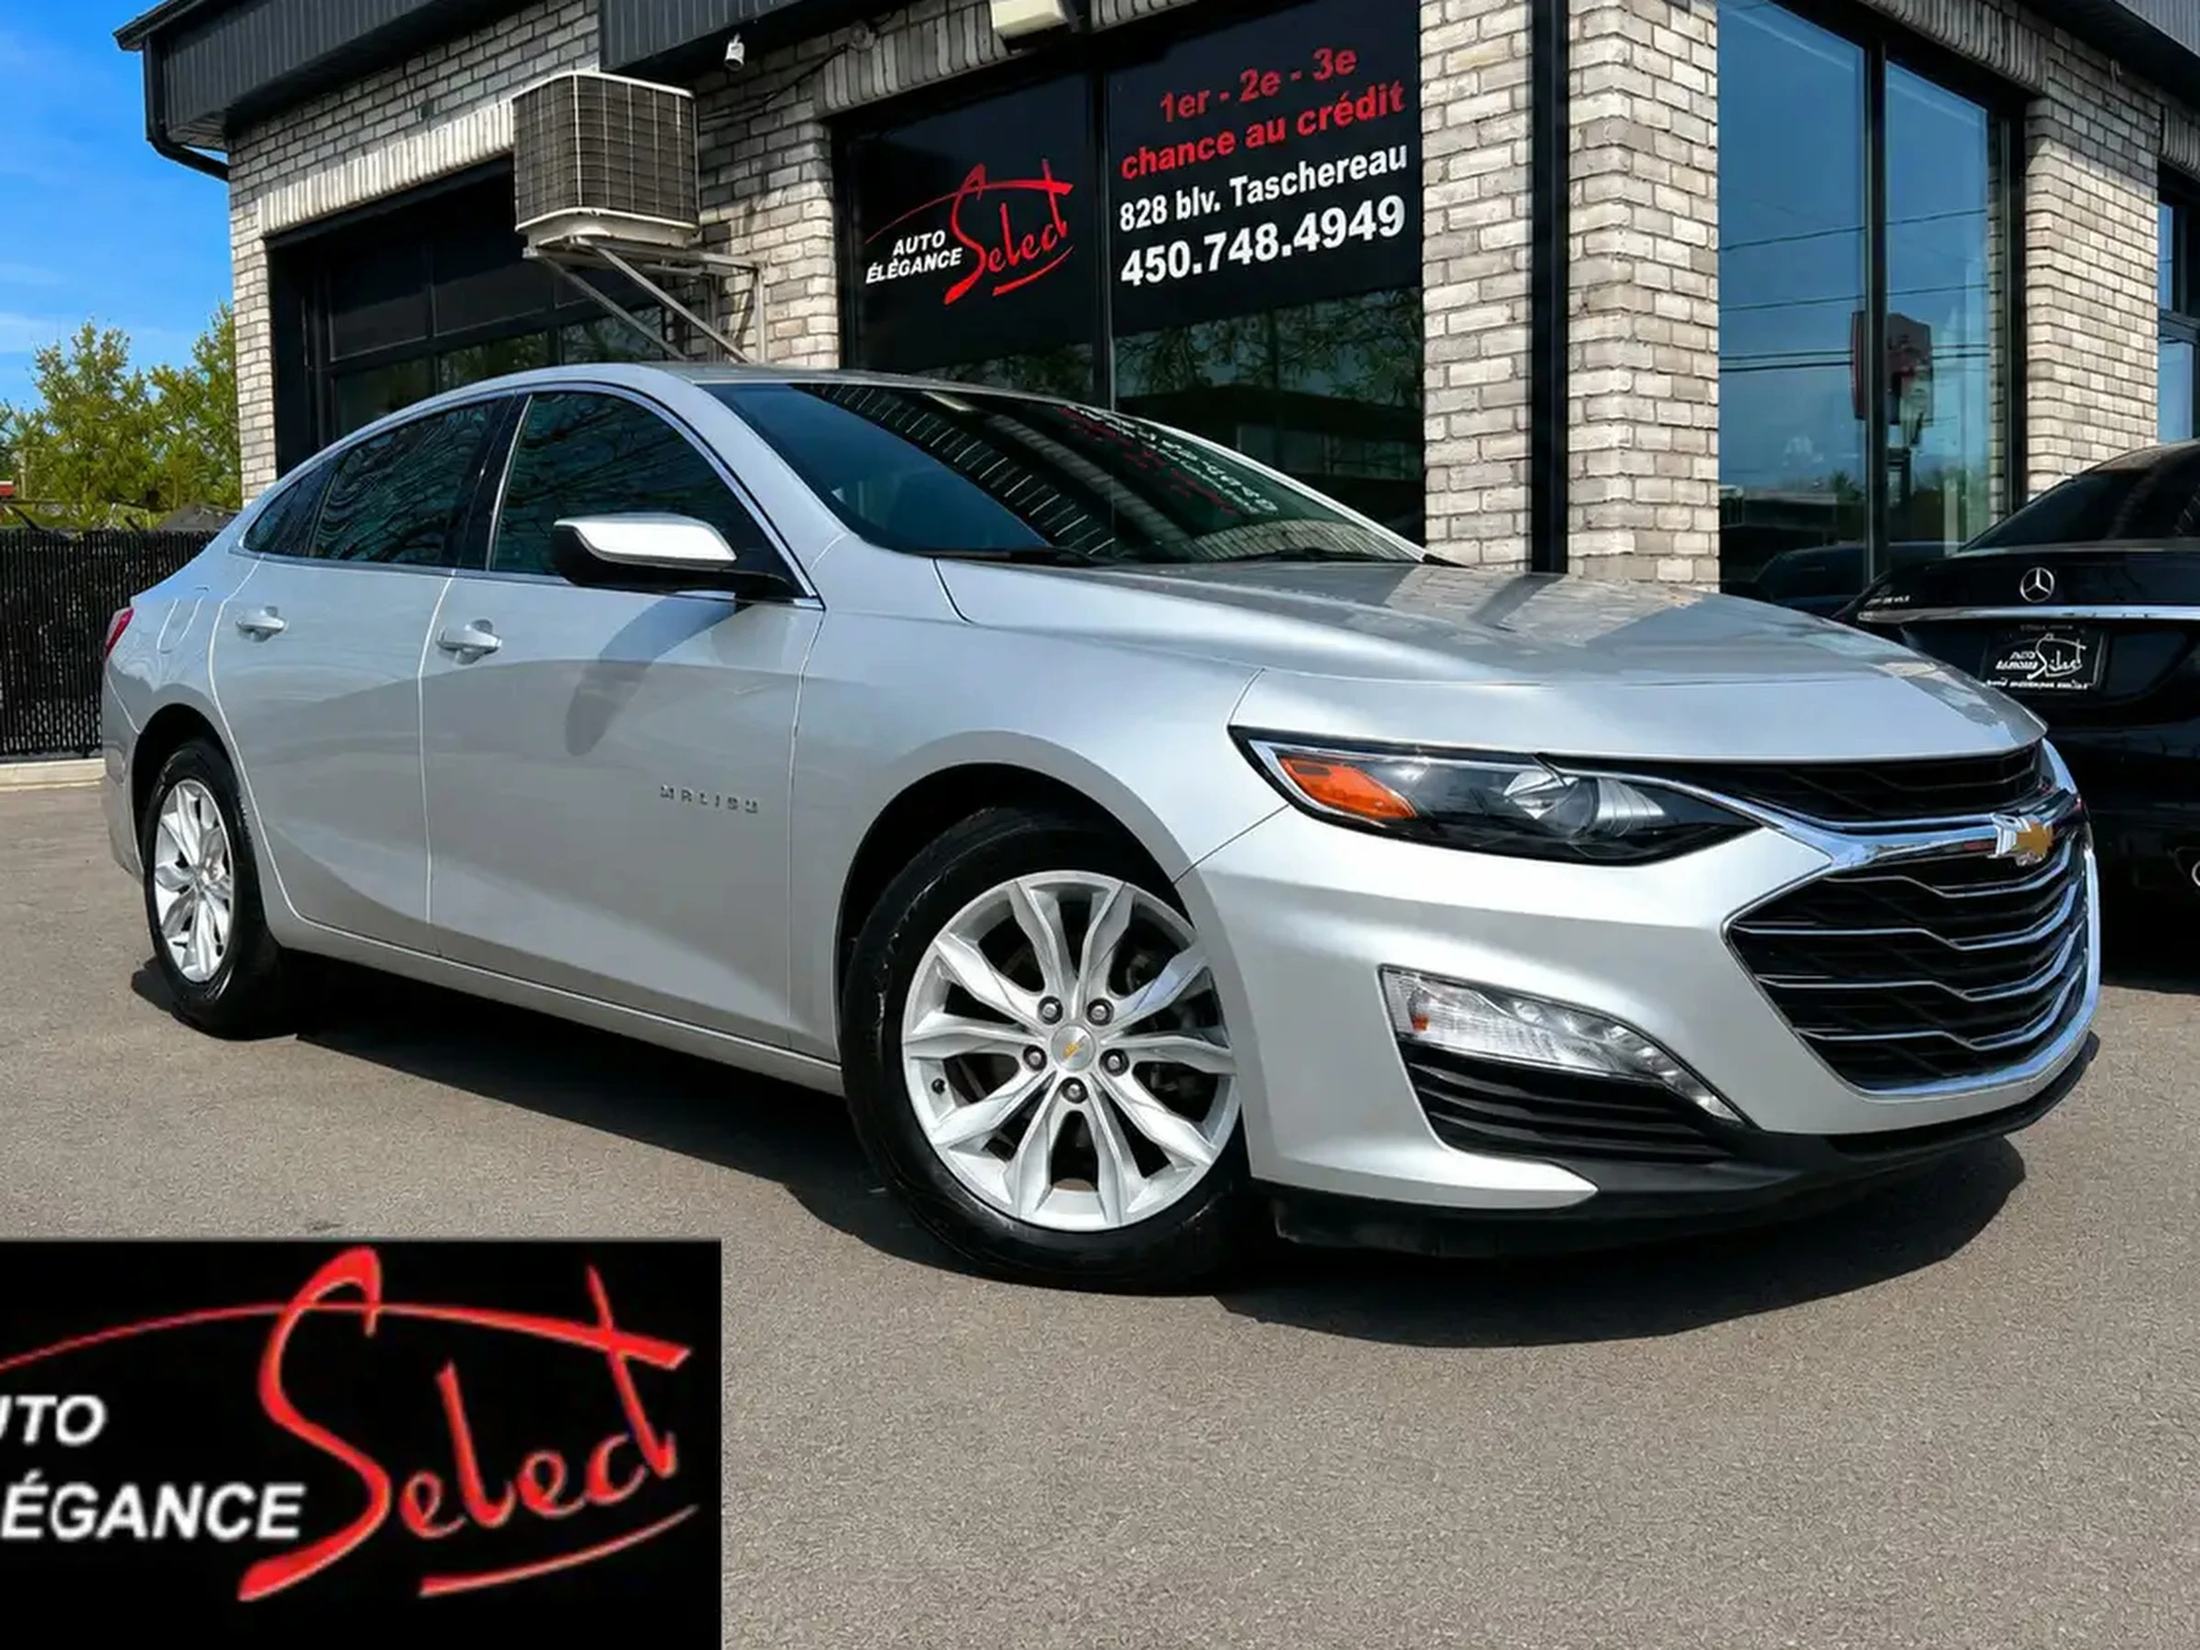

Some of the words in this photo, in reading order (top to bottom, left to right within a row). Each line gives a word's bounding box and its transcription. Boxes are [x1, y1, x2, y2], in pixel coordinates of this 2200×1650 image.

[1120, 130, 1237, 180] chance
[1245, 115, 1287, 150] au
[1296, 79, 1407, 137] crédit
[1160, 89, 1211, 123] 1er
[1238, 68, 1281, 103] 2e
[1312, 47, 1358, 81] 3e
[943, 157, 1075, 306] Select
[1119, 194, 1169, 232] 828
[1175, 185, 1222, 222] blv.
[1229, 144, 1408, 207] Taschereau
[892, 229, 947, 259] AUTO
[1120, 194, 1407, 287] 450.748.4949
